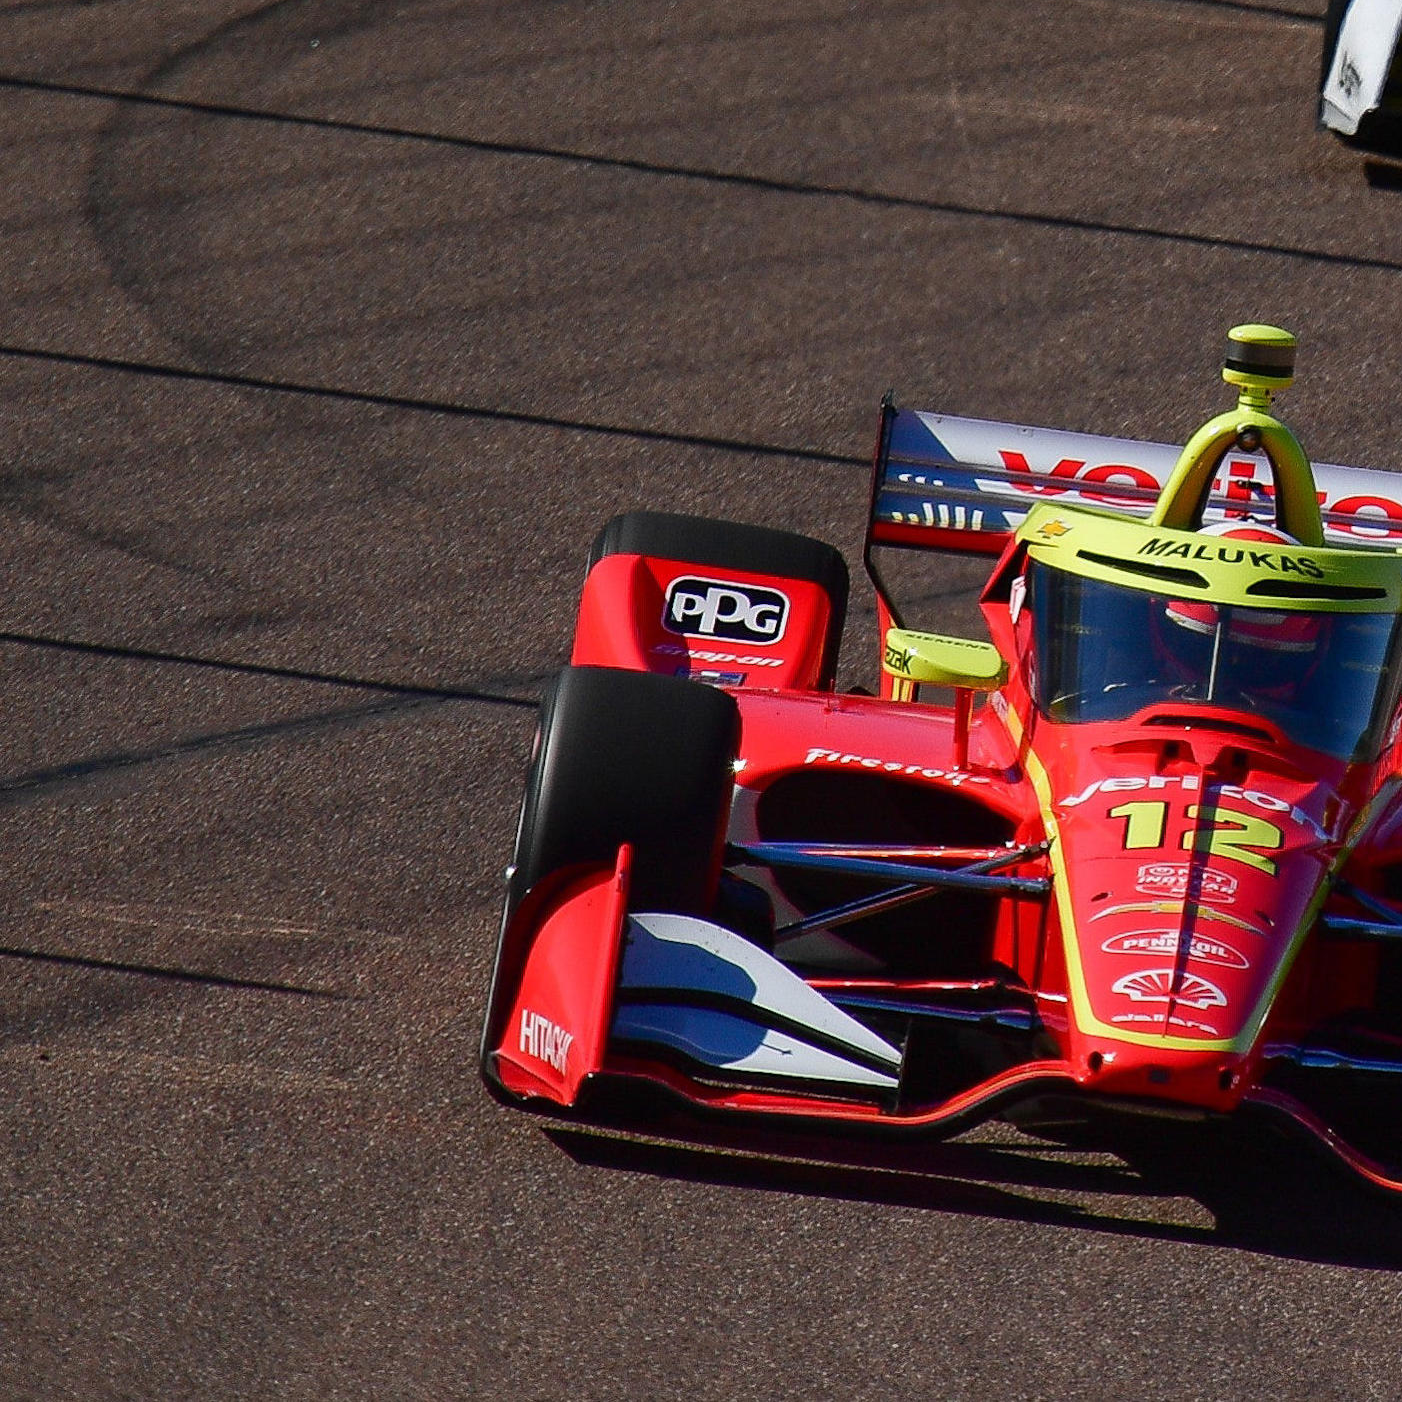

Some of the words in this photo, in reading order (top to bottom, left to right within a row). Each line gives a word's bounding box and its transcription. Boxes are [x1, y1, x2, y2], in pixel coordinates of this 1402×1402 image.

[1138, 537, 1325, 579] MALUKAS
[671, 586, 781, 635] PPG
[1107, 801, 1284, 877] 12
[519, 1008, 574, 1077] HITACHI
